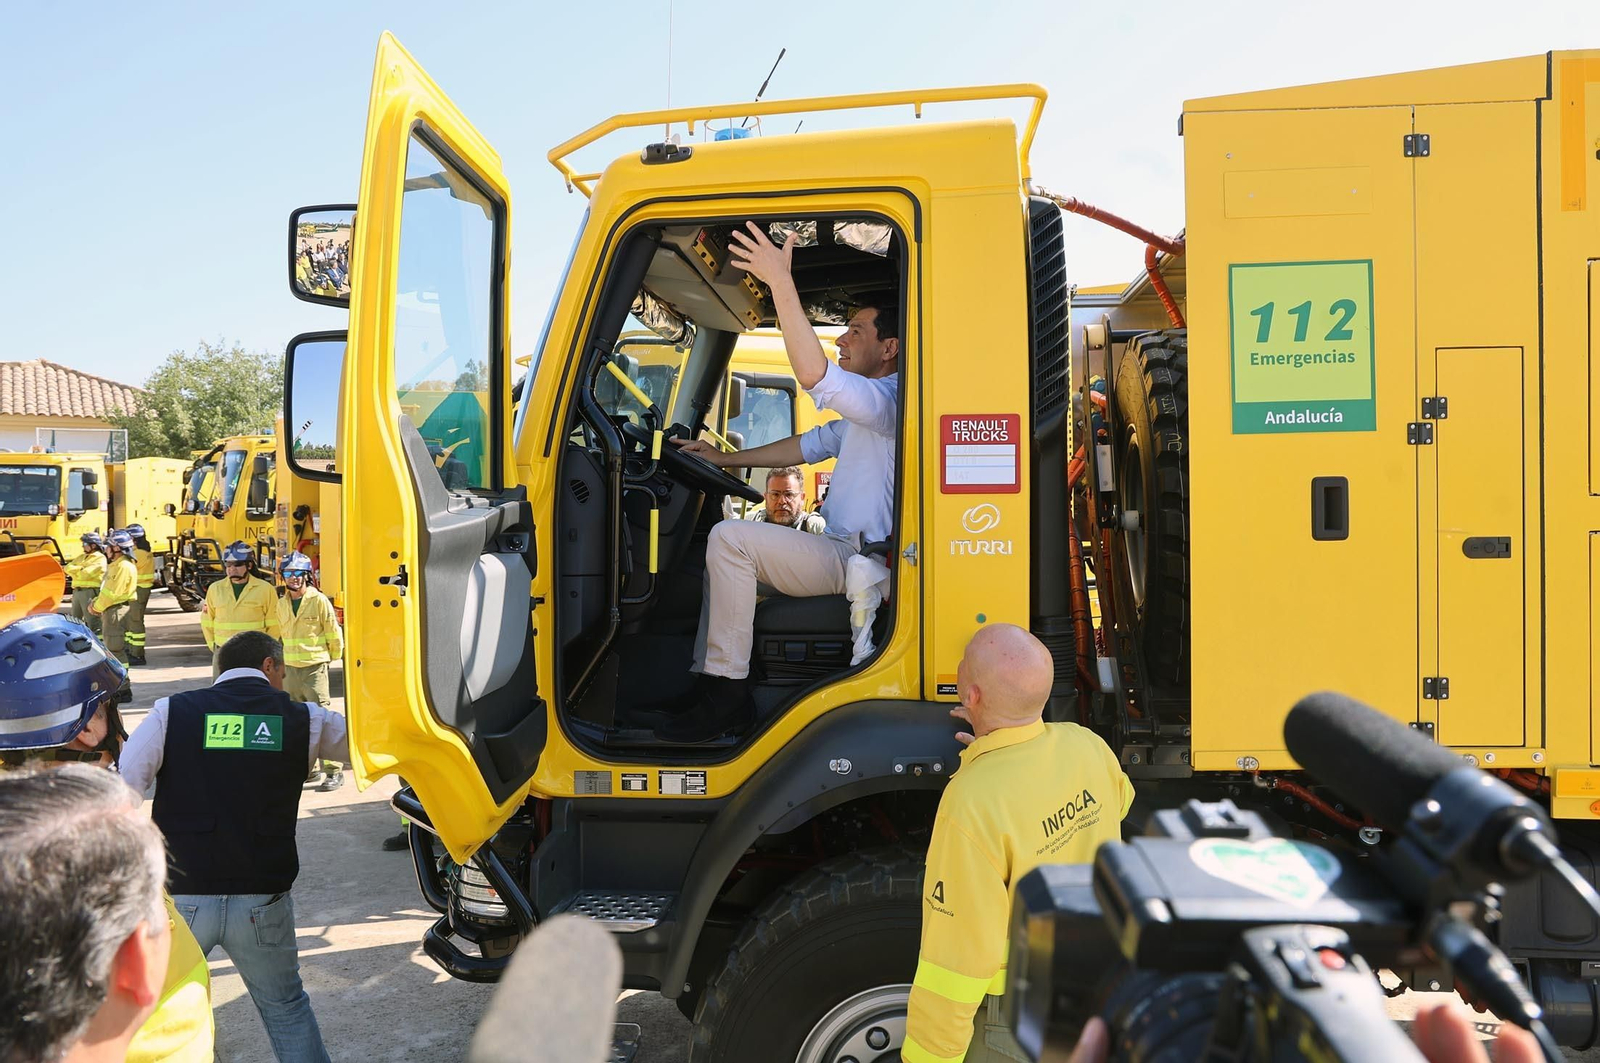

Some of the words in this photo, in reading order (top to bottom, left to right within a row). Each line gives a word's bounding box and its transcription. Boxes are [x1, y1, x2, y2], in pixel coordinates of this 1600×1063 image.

[1250, 299, 1357, 343] 112
[1250, 349, 1356, 368] Emergencias
[1265, 407, 1343, 424] Andalucía
[952, 420, 1008, 431] RENAULT
[952, 431, 1009, 442] TRUCKS
[950, 540, 1012, 555] ITURRI
[210, 722, 242, 736] 112
[1042, 789, 1097, 838] INFOCA
